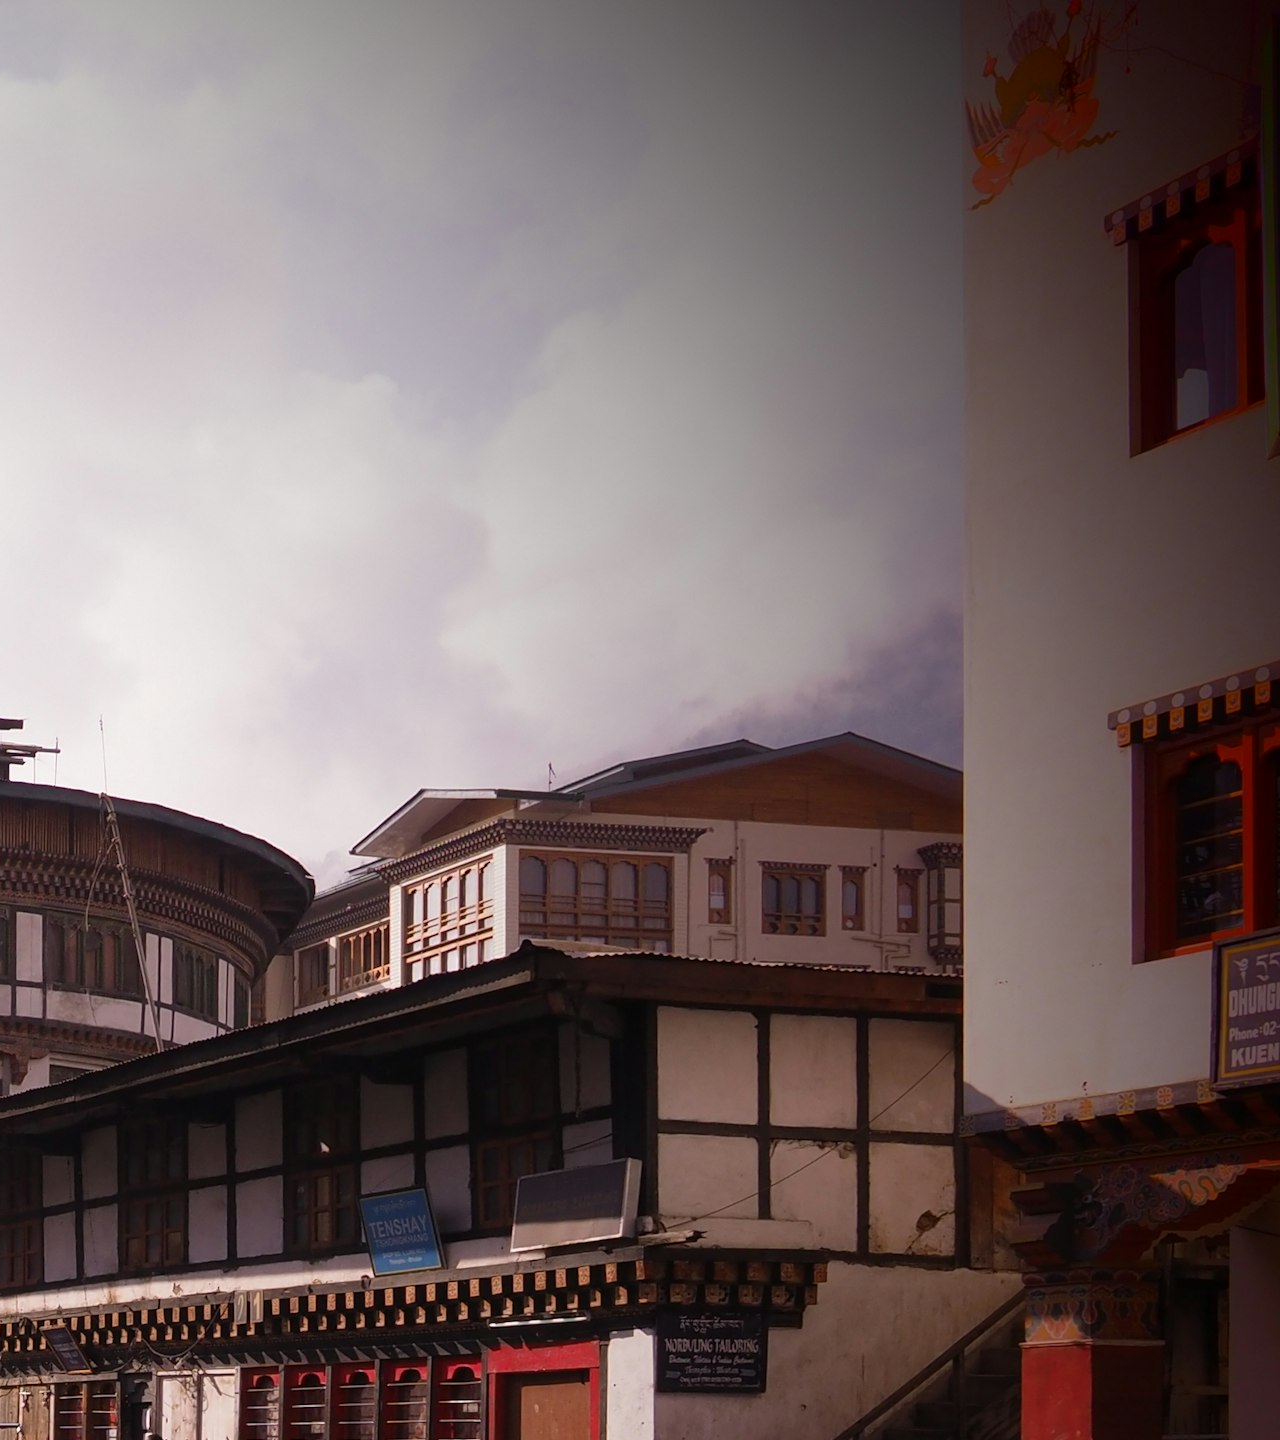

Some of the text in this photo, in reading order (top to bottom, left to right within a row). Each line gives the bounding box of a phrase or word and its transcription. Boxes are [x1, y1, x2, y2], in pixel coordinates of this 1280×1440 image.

[368, 1214, 426, 1239] TENSHAY
[664, 1338, 760, 1353] NORBULING TAILORING
